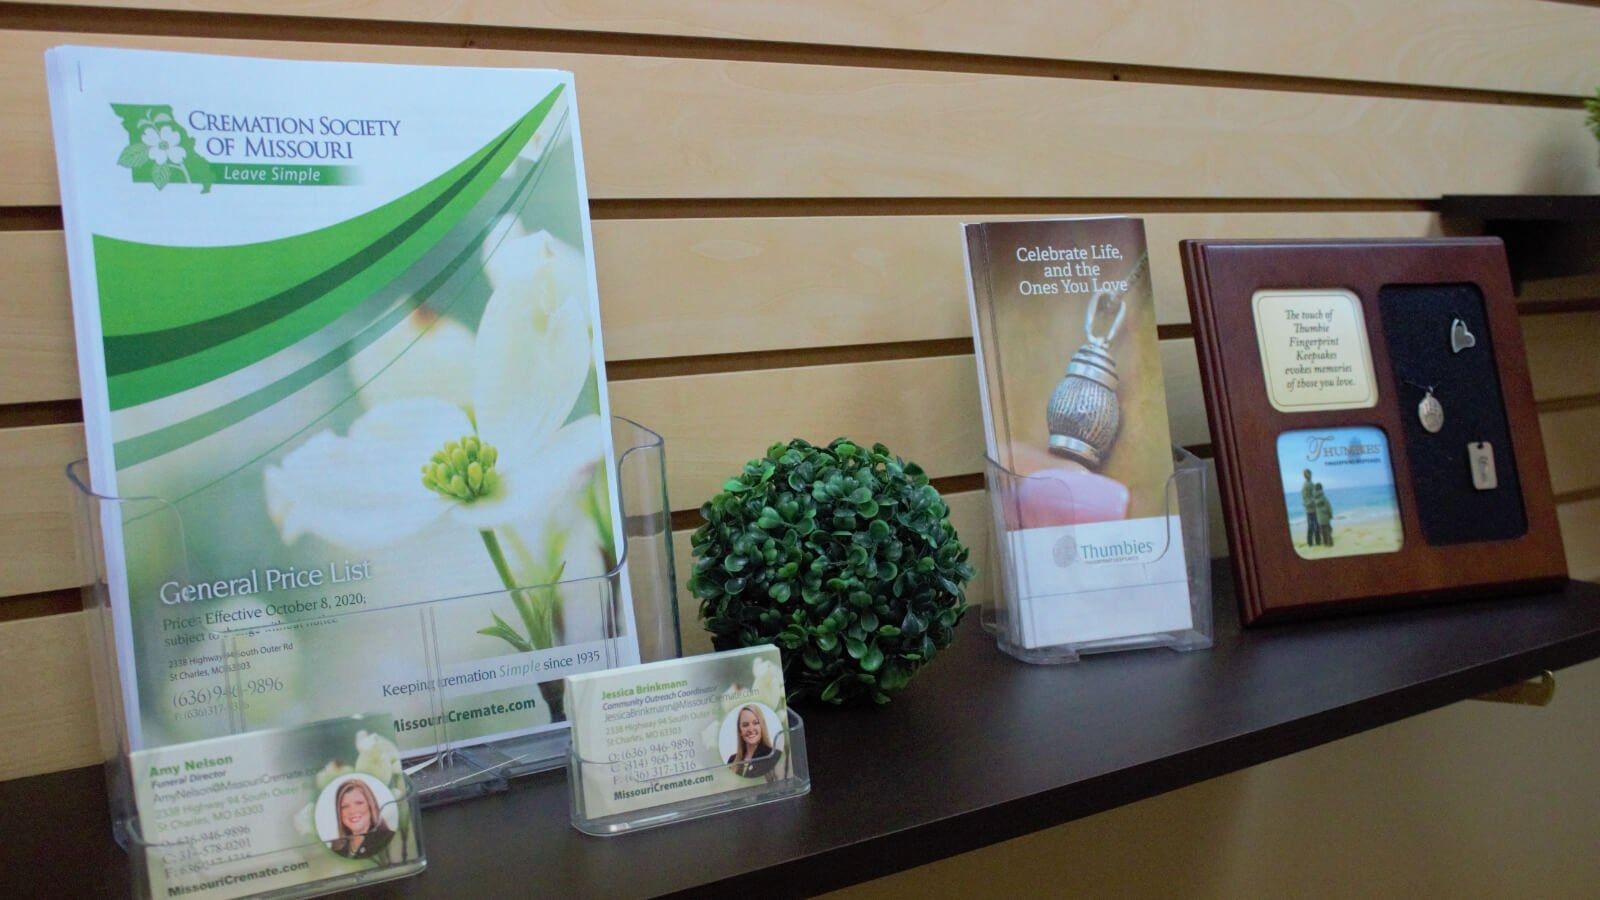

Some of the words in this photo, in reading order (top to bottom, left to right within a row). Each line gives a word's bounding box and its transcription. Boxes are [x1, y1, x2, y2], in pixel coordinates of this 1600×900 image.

[188, 110, 314, 135] CREMATION
[319, 116, 401, 137] SOCIETY
[206, 137, 235, 157] OF
[244, 138, 353, 159] MISSOURI
[223, 165, 266, 181] Leave
[271, 166, 321, 182] Simple
[1016, 246, 1088, 262] Celebrate
[1090, 244, 1123, 261] Life,
[1044, 262, 1072, 278] and
[1075, 261, 1101, 276] the
[1019, 280, 1059, 296] Ones
[1060, 279, 1089, 294] You
[1092, 278, 1128, 293] Love
[1285, 309, 1300, 320] The
[1301, 309, 1323, 320] touch
[1325, 309, 1334, 321] of
[1289, 336, 1339, 350] Fingerprint
[1296, 350, 1337, 363] Keepsakes
[1285, 364, 1312, 375] evokes
[1314, 363, 1352, 374] memories
[1286, 378, 1297, 392] of
[1297, 378, 1318, 389] those
[1319, 379, 1335, 391] you
[1080, 540, 1153, 560] Thumbies
[160, 569, 258, 605] General
[266, 568, 323, 592] Price
[331, 560, 371, 583] List
[205, 607, 262, 625] Effective
[265, 599, 317, 617] October
[320, 597, 332, 610] 8,
[164, 632, 205, 648] subject
[189, 654, 223, 668] Highway
[234, 647, 259, 658] outh
[260, 644, 282, 655] Outer
[283, 642, 293, 652] Rd
[499, 660, 541, 678] Simple
[543, 656, 573, 670] since
[577, 650, 600, 665] 1935
[601, 687, 635, 701] Jessica
[635, 679, 688, 694] Brinkmann
[602, 697, 643, 712] Community
[645, 691, 676, 704] Outreach
[393, 697, 536, 733] issourCremate.com
[149, 765, 180, 779] Amy
[184, 755, 233, 771] Nelson
[151, 774, 188, 790] Funeral
[189, 769, 227, 784] Director
[613, 772, 714, 801] MissouriCremate.com
[167, 860, 310, 898] MissouriCremate.com
